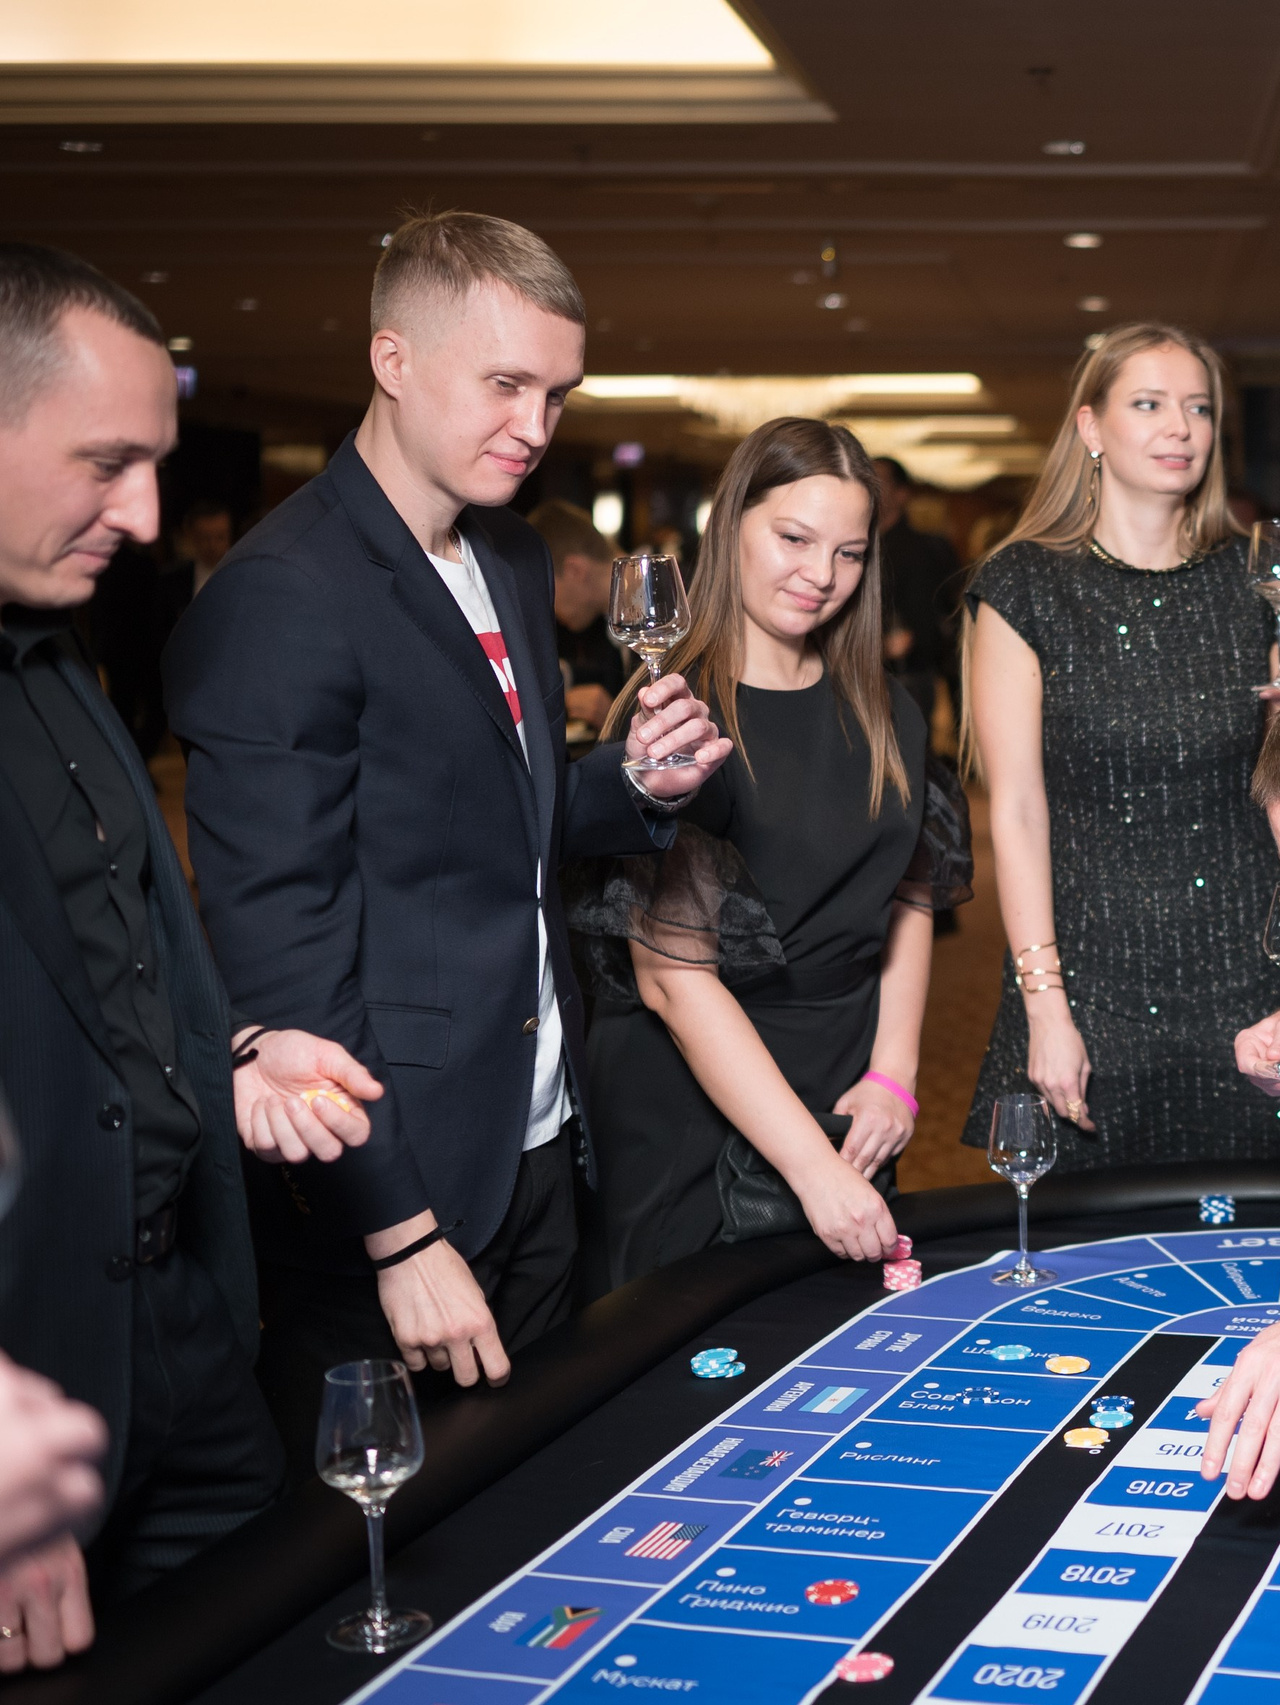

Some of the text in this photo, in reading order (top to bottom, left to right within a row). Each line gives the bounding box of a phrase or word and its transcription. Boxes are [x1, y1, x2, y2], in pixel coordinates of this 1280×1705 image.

[1113, 1276, 1166, 1298] Алиготе
[1021, 1305, 1101, 1320] Вердехо
[762, 1381, 815, 1412] АРГЕНТИНА
[898, 1400, 955, 1411] Блан
[839, 1451, 941, 1466] Рислинг
[1159, 1443, 1203, 1457] 015
[662, 1437, 745, 1493] НОВАЯ ЗЕЛАНДИЯ
[1125, 1479, 1194, 1497] 2016
[776, 1508, 879, 1527] Гевюрц-
[598, 1526, 635, 1544] США
[765, 1521, 886, 1541] траминер
[1096, 1521, 1165, 1539] 2017
[1060, 1564, 1136, 1586] 2018
[695, 1579, 767, 1598] Пино
[678, 1593, 800, 1615] Гриджио
[1023, 1613, 1100, 1634] 2019
[592, 1666, 699, 1692] Мускат
[973, 1663, 1066, 1690] 2020
